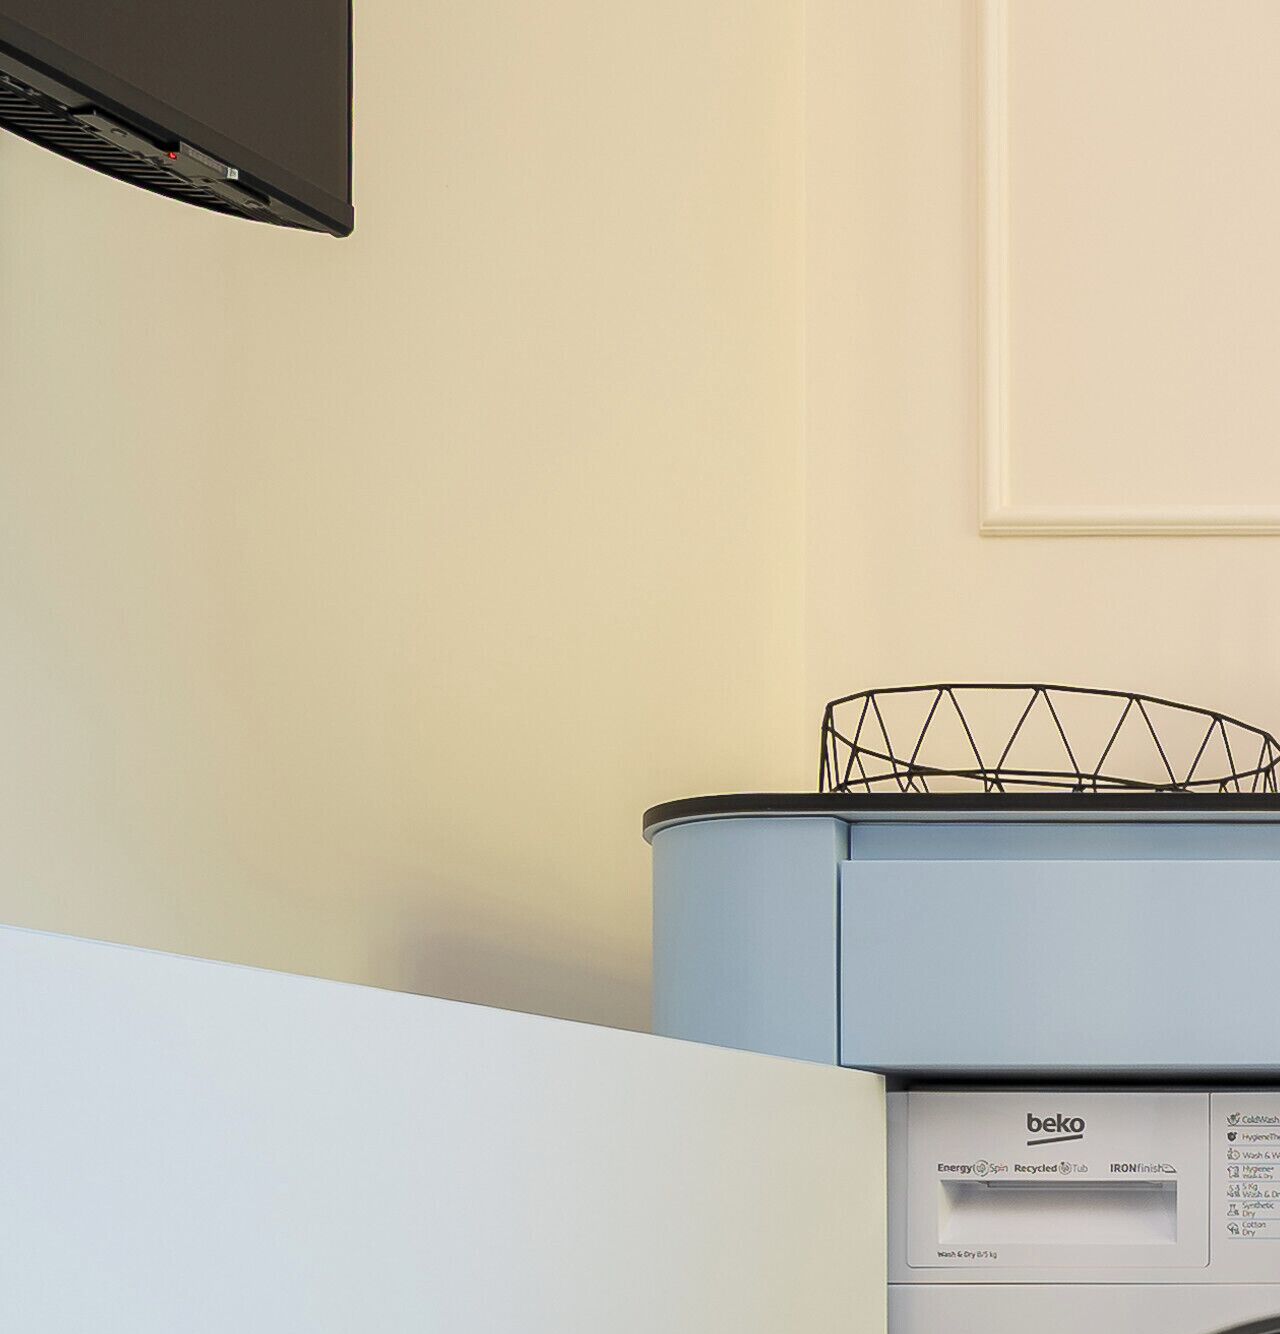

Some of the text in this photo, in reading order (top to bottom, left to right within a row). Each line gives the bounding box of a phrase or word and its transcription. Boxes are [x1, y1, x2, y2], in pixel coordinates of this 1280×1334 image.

[1027, 1113, 1085, 1133] beko
[937, 1163, 1008, 1173] Energy Spin
[1014, 1163, 1088, 1173] Recycled Tub
[1242, 1210, 1255, 1218] Dry
[1242, 1229, 1256, 1237] Dry
